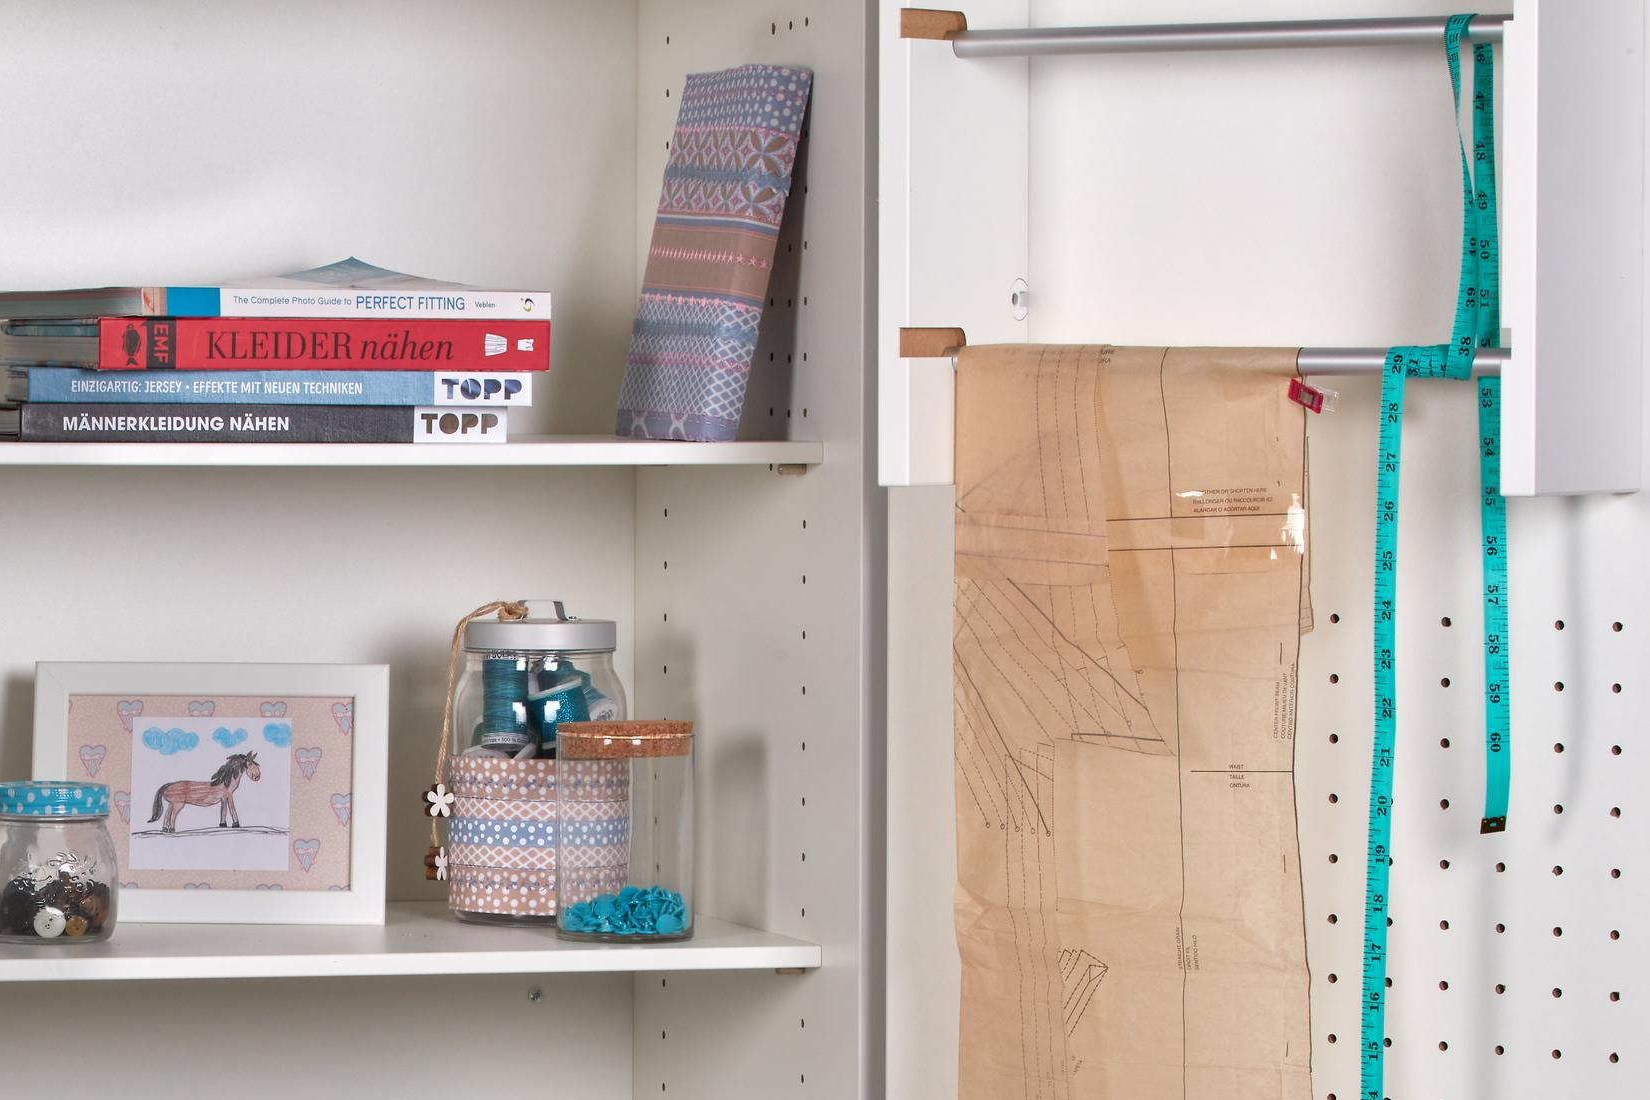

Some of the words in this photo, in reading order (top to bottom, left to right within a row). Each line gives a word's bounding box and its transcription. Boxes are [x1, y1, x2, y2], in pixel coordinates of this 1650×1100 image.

[1476, 141, 1486, 160] 48
[1478, 190, 1487, 210] 49
[1480, 240, 1490, 260] 50
[233, 296, 248, 304] The
[251, 297, 289, 306] Complete
[292, 297, 315, 305] Photo
[318, 297, 341, 305] Guide
[356, 296, 413, 309] PERFECT
[418, 296, 465, 310] FITTING
[1466, 288, 1476, 308] 39
[1480, 289, 1490, 308] 51
[153, 324, 169, 364] EMF
[206, 330, 352, 359] KLEIDER
[360, 330, 454, 360] nähen
[1458, 336, 1472, 356] 38
[1392, 354, 1404, 374] 29
[71, 379, 141, 393] EINZIGARTIG:
[144, 380, 182, 394] JERSEY
[193, 380, 236, 394] EFFEKTE
[240, 380, 261, 394] MIT
[264, 381, 300, 394] NEUEN
[303, 381, 363, 395] TECHNIKEN
[441, 378, 523, 400] TOPP
[1482, 388, 1492, 408] 53
[64, 412, 224, 431] MÄNNERKLEIDUNG
[230, 412, 289, 431] NÄHEN
[1388, 403, 1398, 423] 28
[420, 413, 498, 434] TOPP
[1484, 437, 1495, 457] 54
[1386, 452, 1397, 472] 27
[1486, 486, 1496, 506] 55
[1384, 501, 1394, 522] 26
[1486, 536, 1497, 556] 56
[1383, 551, 1392, 571] 25
[1487, 584, 1499, 605] 57
[1382, 600, 1392, 621] 24
[1488, 634, 1500, 654] 58
[1382, 649, 1392, 670] 23
[1489, 683, 1500, 704] 59
[1382, 698, 1392, 719] 22
[1490, 733, 1502, 752] 60
[1380, 747, 1390, 768] 21
[1377, 796, 1387, 816] 20
[1375, 844, 1386, 864] 19
[1373, 894, 1384, 914] 18
[1371, 943, 1381, 962] 17
[1370, 991, 1380, 1012] 16
[1368, 1041, 1378, 1060] 15
